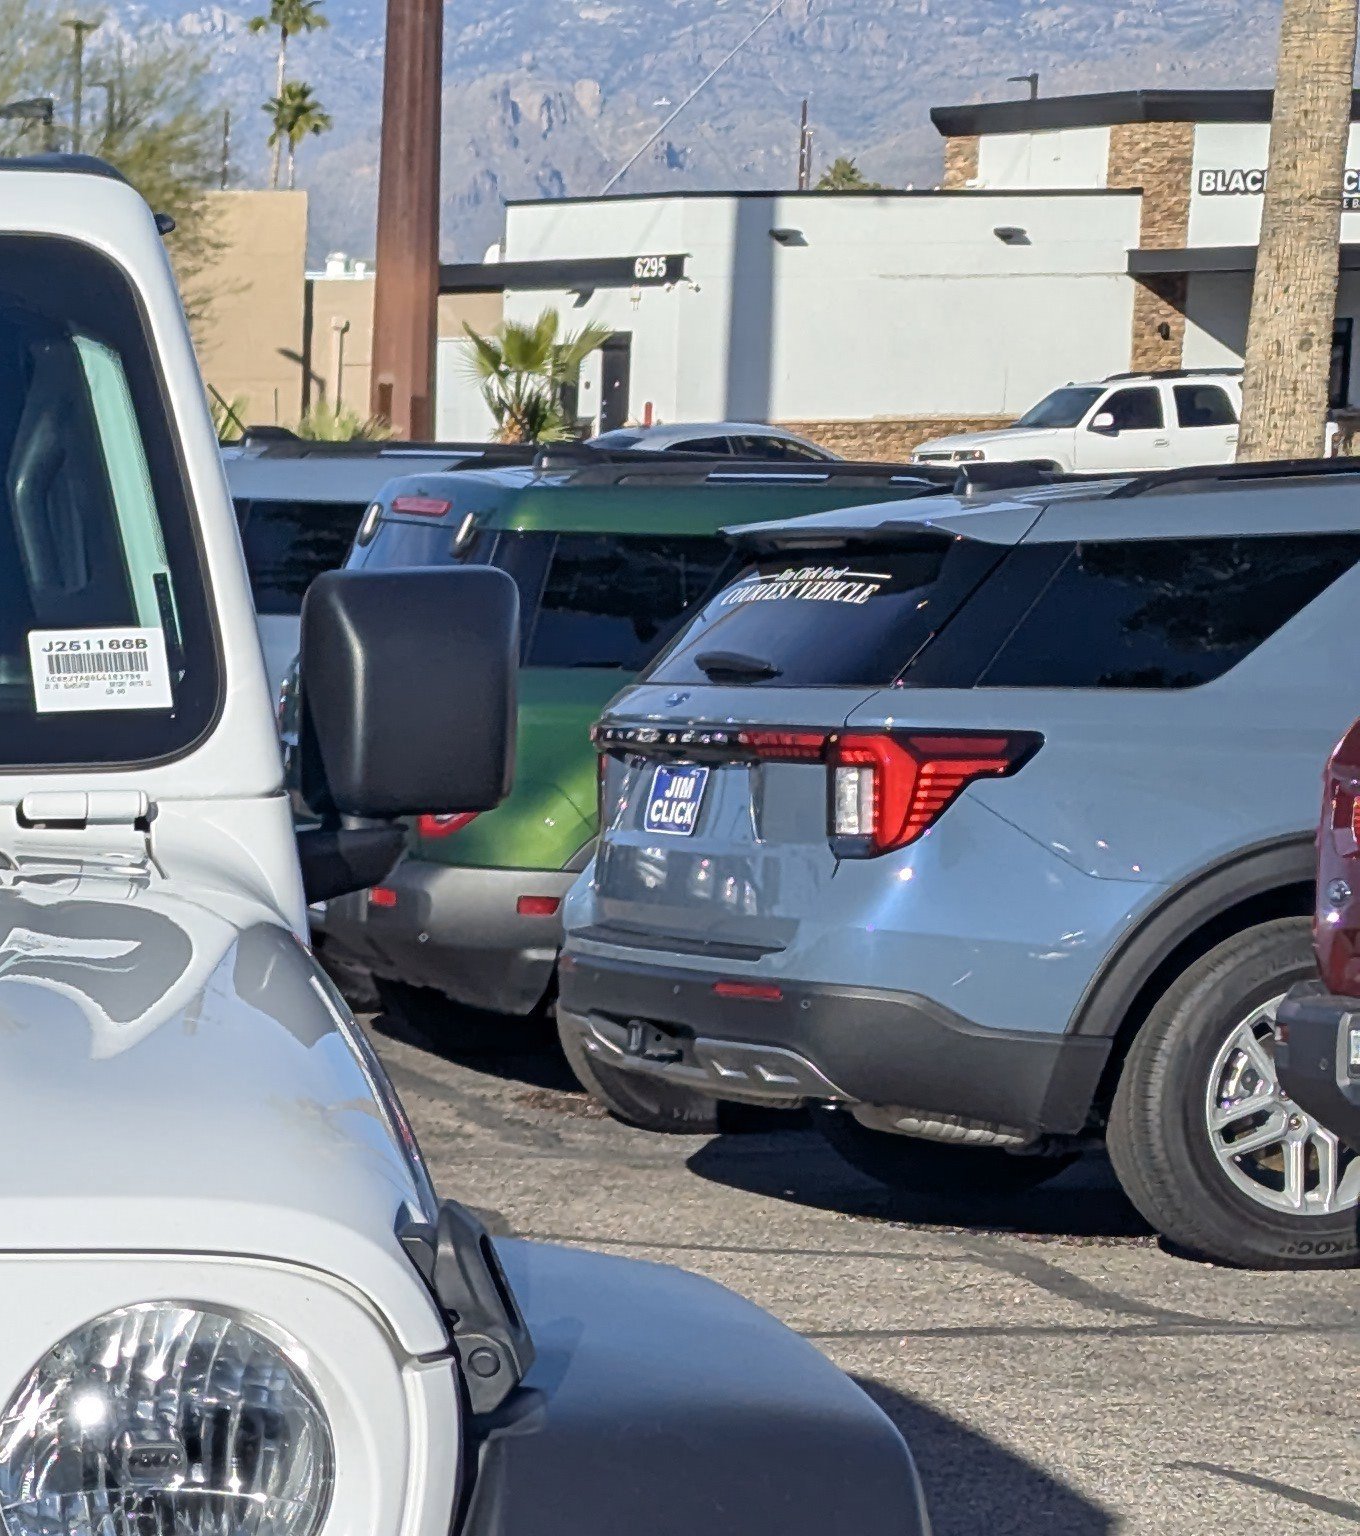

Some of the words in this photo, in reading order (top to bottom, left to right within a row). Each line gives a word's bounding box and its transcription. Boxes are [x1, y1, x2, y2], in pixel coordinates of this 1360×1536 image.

[634, 257, 667, 278] 6295
[721, 582, 804, 605] COURTESY
[795, 580, 880, 604] VEHICLE
[665, 776, 695, 798] JIM
[651, 800, 696, 824] CLICK
